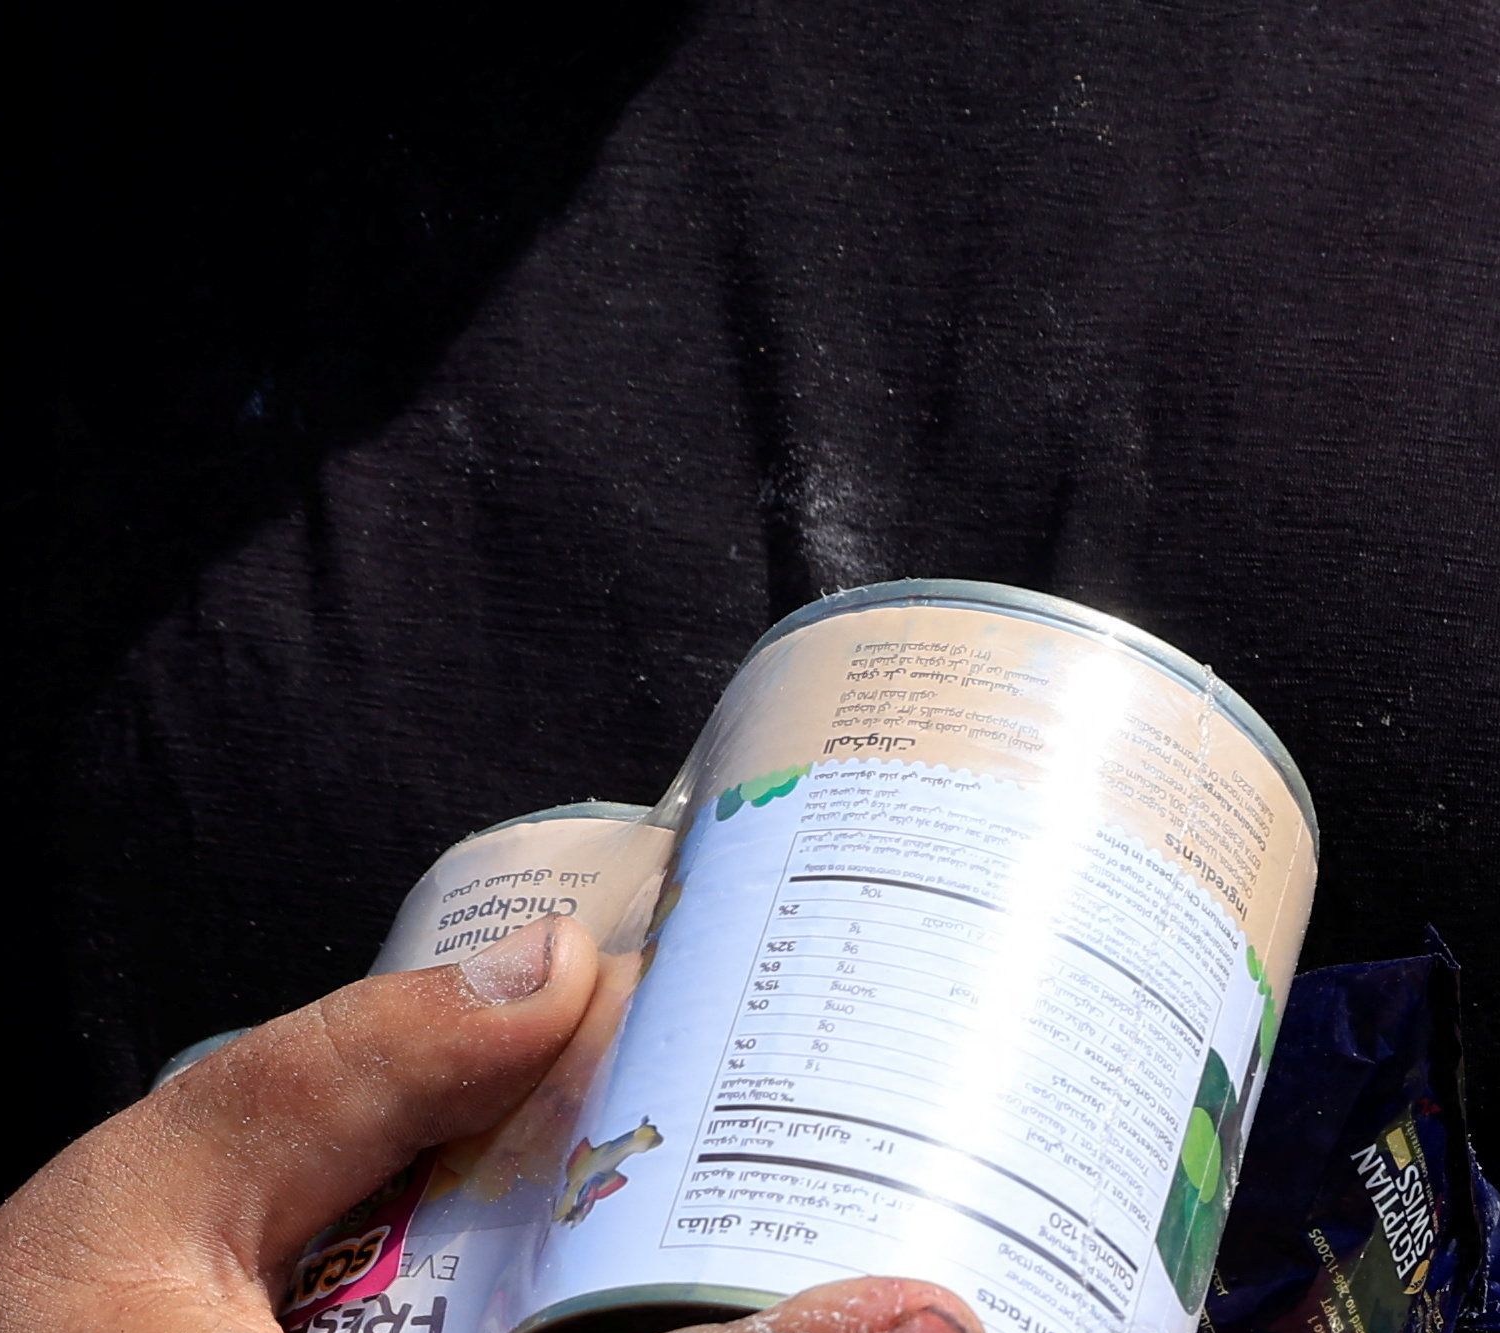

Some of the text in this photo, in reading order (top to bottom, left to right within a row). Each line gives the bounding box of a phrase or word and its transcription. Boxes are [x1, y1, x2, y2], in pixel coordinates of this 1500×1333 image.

[909, 668, 958, 685] مسببات
[824, 736, 915, 753] المكونات
[878, 769, 900, 783] فاخر
[918, 774, 951, 790] محلول
[1122, 767, 1169, 800] Calcium
[1128, 733, 1269, 851] Contains This Product
[1205, 768, 1273, 837] Contain Traces Of
[1093, 827, 1132, 856] brine
[1128, 848, 1145, 864] in
[440, 865, 599, 903] حمص مسلوق فاخر
[1092, 878, 1123, 902] After
[1158, 830, 1252, 921] Ingredients
[859, 883, 883, 901] 10g
[1104, 854, 1202, 929] Use days of
[437, 896, 577, 933] Chickpeas
[778, 902, 799, 916] 2%
[848, 921, 862, 937] 1g
[1195, 901, 1242, 952] Premium
[766, 939, 859, 957] 9g 32%
[758, 959, 856, 977] 17g 6%
[1064, 967, 1102, 995] sugar
[753, 978, 877, 1000] 340mg 15%
[1097, 987, 1136, 1019] added
[822, 998, 855, 1017] 0mg
[816, 1019, 835, 1035] 0g
[1143, 1022, 1186, 1061] Includes
[1165, 1018, 1205, 1056] Protein
[810, 1038, 828, 1054] 0g
[803, 1057, 821, 1074] 1g
[1132, 1058, 1177, 1099] Dietary
[1151, 1051, 1182, 1079] Total
[747, 1088, 777, 1102] Daily
[707, 1114, 852, 1148] السعرات الحرارية
[1137, 1110, 1179, 1152] Sodium
[1153, 1102, 1184, 1133] Total
[739, 1136, 774, 1150] الحصة
[1077, 1136, 1101, 1158] Fat
[1114, 1116, 1173, 1171] Cholesterol
[1122, 1147, 1153, 1176] Trans
[685, 1183, 725, 1201] الكمية
[728, 1185, 784, 1206] المقدمة
[786, 1192, 829, 1211] تحتوي
[691, 1166, 734, 1184] الكمية
[830, 1181, 869, 1202] كوب
[1107, 1184, 1132, 1207] Fat
[1125, 1201, 1155, 1231] Total
[1348, 1142, 1423, 1279] EGYPTIAN
[1390, 1164, 1439, 1254] SWISS
[676, 1211, 818, 1245] حقائق غذائية
[1045, 1209, 1082, 1242] 120
[995, 1239, 1057, 1285] cup (130g)
[1034, 1223, 1133, 1307] Amount Serving
[971, 1284, 1034, 1332] Facts
[1003, 1267, 1076, 1322] per container
